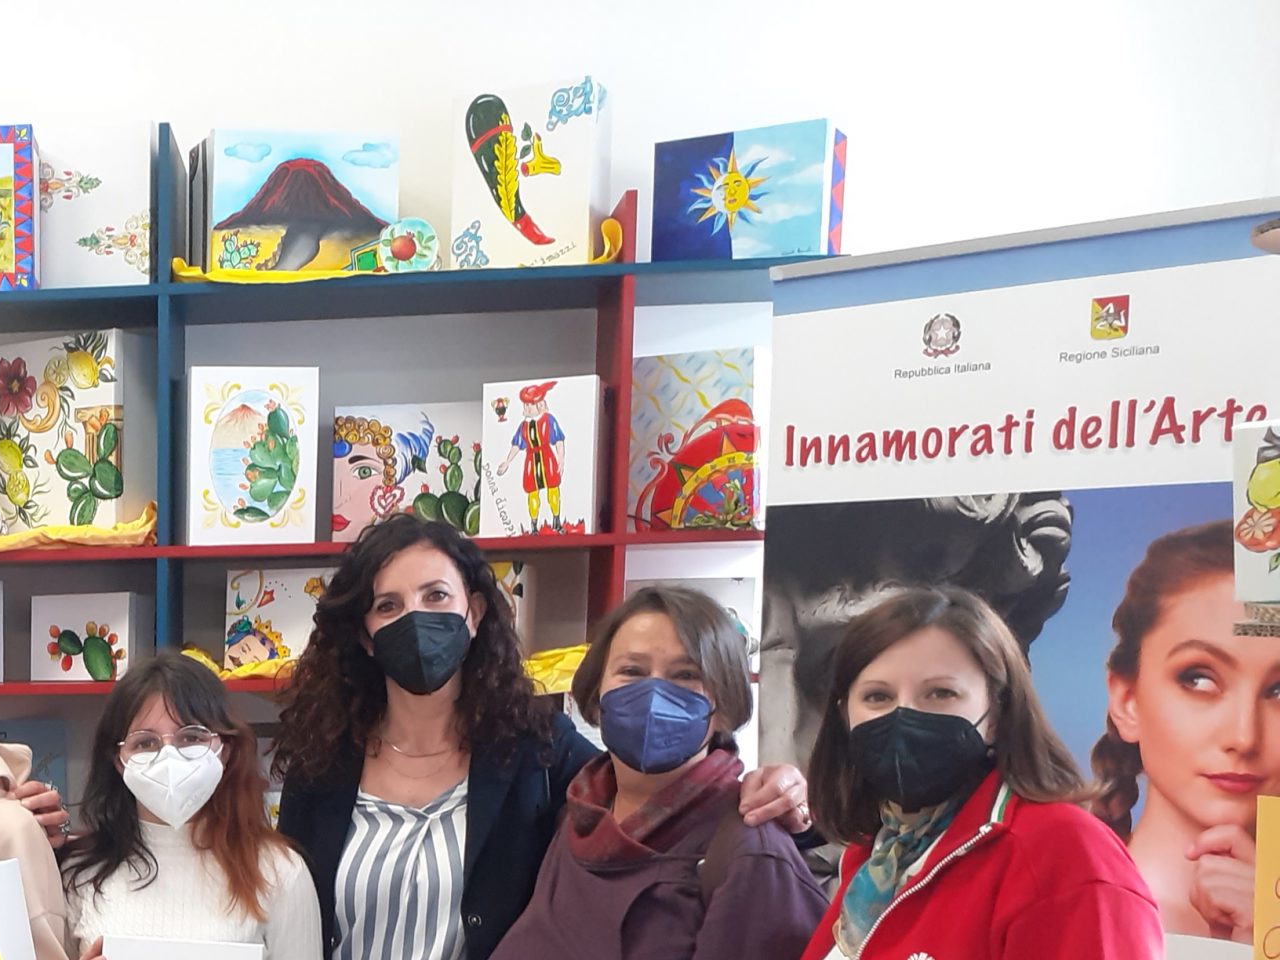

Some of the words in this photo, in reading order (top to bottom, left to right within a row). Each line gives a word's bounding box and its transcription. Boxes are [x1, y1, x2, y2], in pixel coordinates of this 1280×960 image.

[1059, 350, 1108, 364] Regione
[1111, 344, 1160, 358] Siciliana
[894, 366, 951, 380] Repubblica
[954, 361, 991, 373] Italiana
[784, 409, 1035, 467] Innamorati
